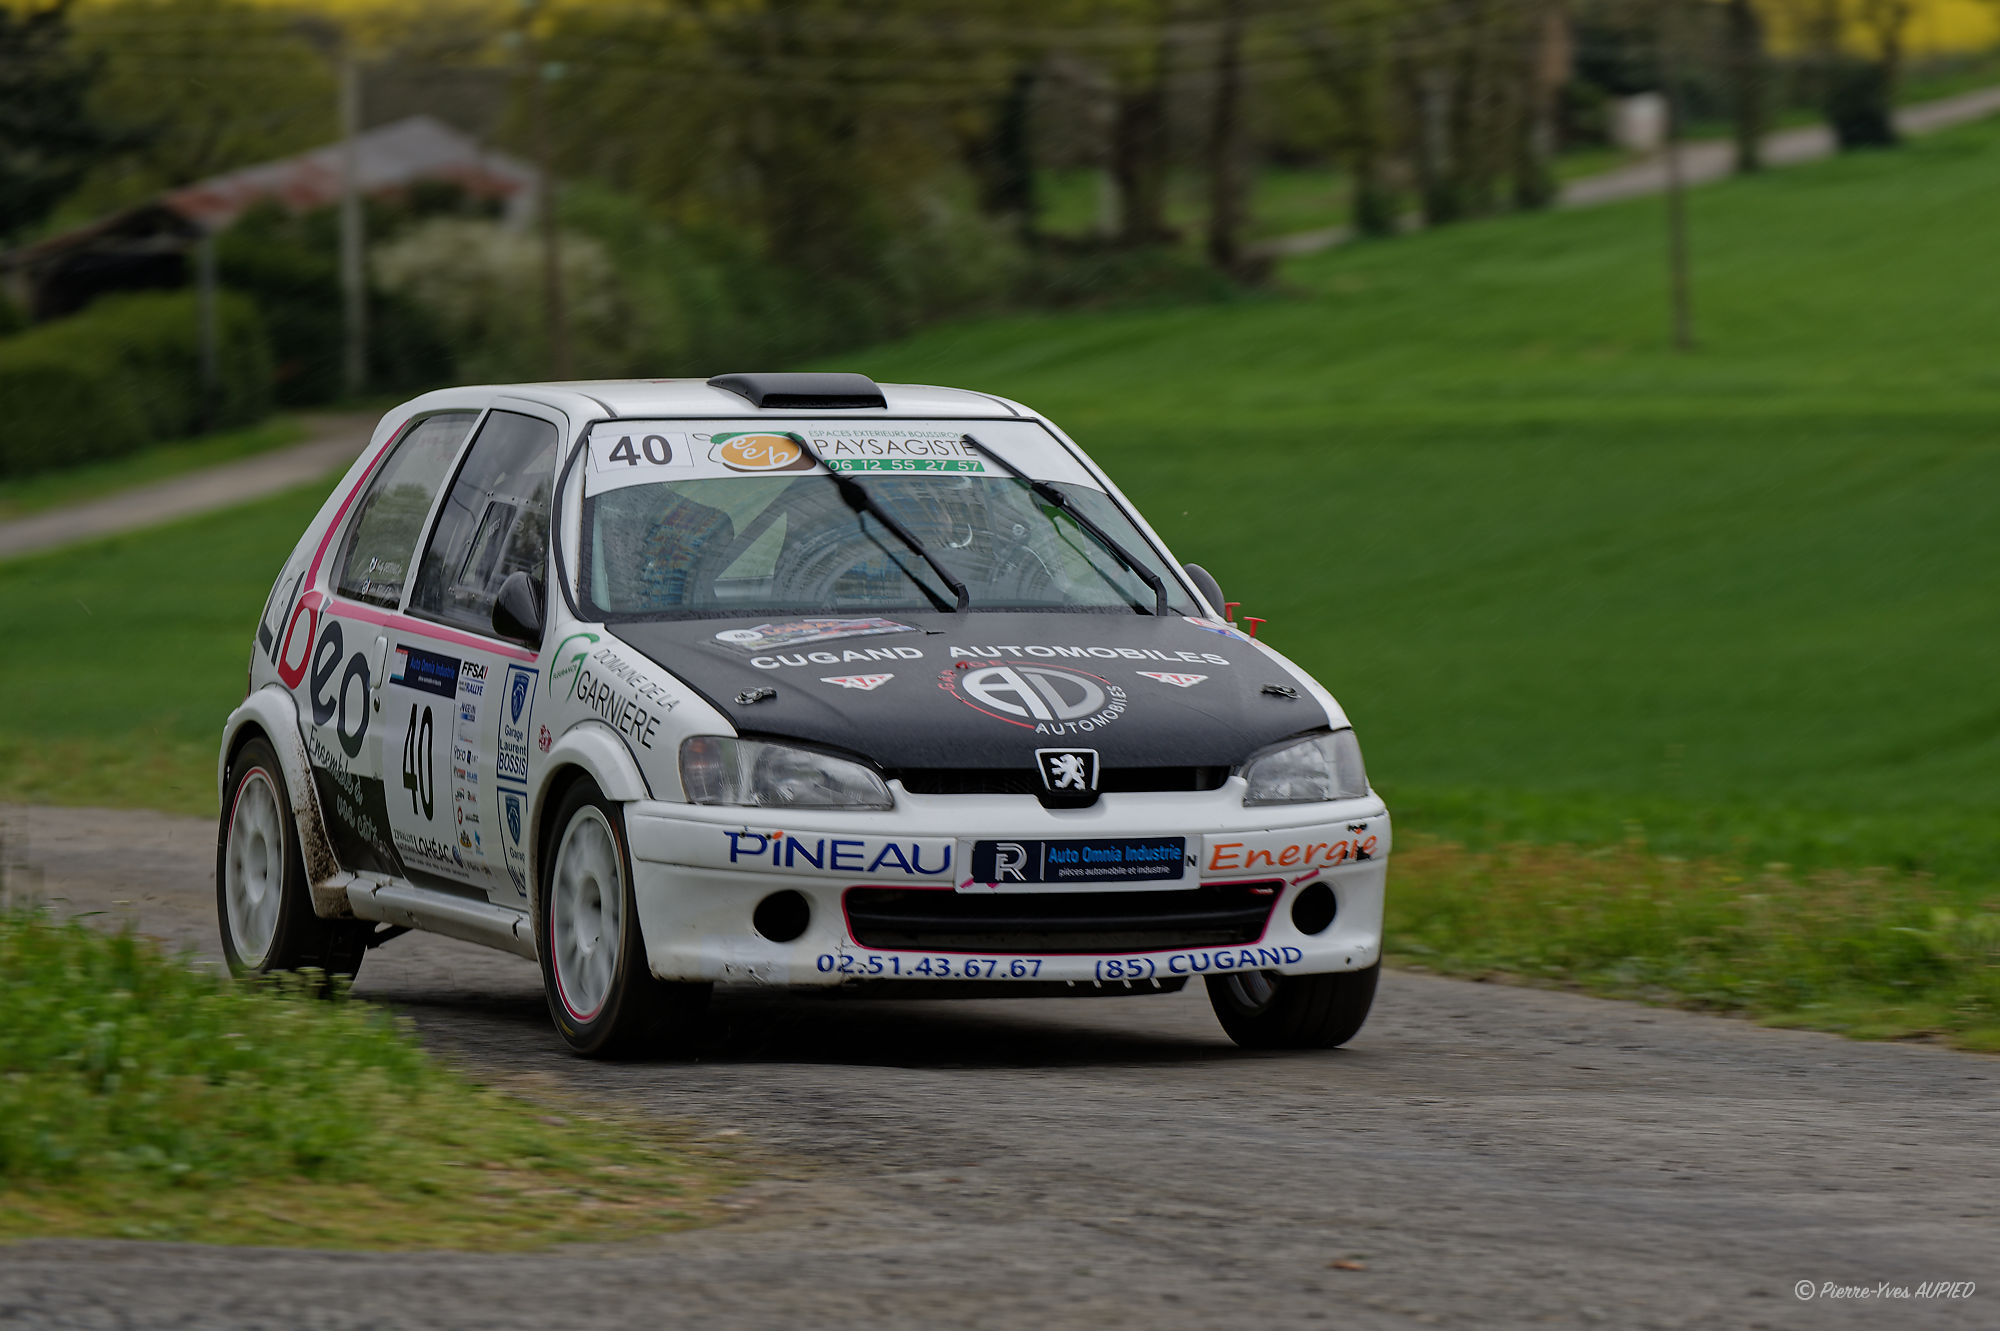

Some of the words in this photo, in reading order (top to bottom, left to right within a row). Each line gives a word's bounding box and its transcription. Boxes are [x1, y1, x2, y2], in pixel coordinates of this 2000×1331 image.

[853, 430, 906, 438] EXTERIEURS
[608, 435, 673, 466] 40
[813, 439, 978, 456] PAYSAGISTE
[828, 460, 853, 470] 06
[861, 460, 882, 470] 12
[891, 460, 915, 471] 55
[925, 460, 947, 471] 27
[957, 461, 979, 471] 57
[750, 647, 924, 670] CUGAND
[949, 645, 1230, 666] AUTOMOBILES
[461, 661, 486, 680] FFSA
[593, 648, 649, 688] DOMAINE
[638, 682, 666, 700] DE
[656, 693, 680, 712] LA
[576, 670, 661, 750] GARNIÈRE
[1033, 684, 1128, 737] AUTOMOBILES
[504, 725, 524, 742] Garage
[499, 739, 527, 756] Laurent
[402, 703, 434, 822] 40
[498, 752, 527, 776] BOSSIS
[1048, 847, 1079, 864] Auto
[1082, 845, 1122, 863] Omnia
[1125, 843, 1182, 862] Industrie
[1208, 826, 1379, 869] Energie
[1058, 866, 1084, 877] pièces
[1085, 865, 1126, 876] automobile
[1137, 864, 1170, 874] industrie
[816, 954, 1042, 979] 02.51.43.67.67
[1095, 957, 1156, 980] (85)
[1168, 946, 1304, 974] CUGAND
